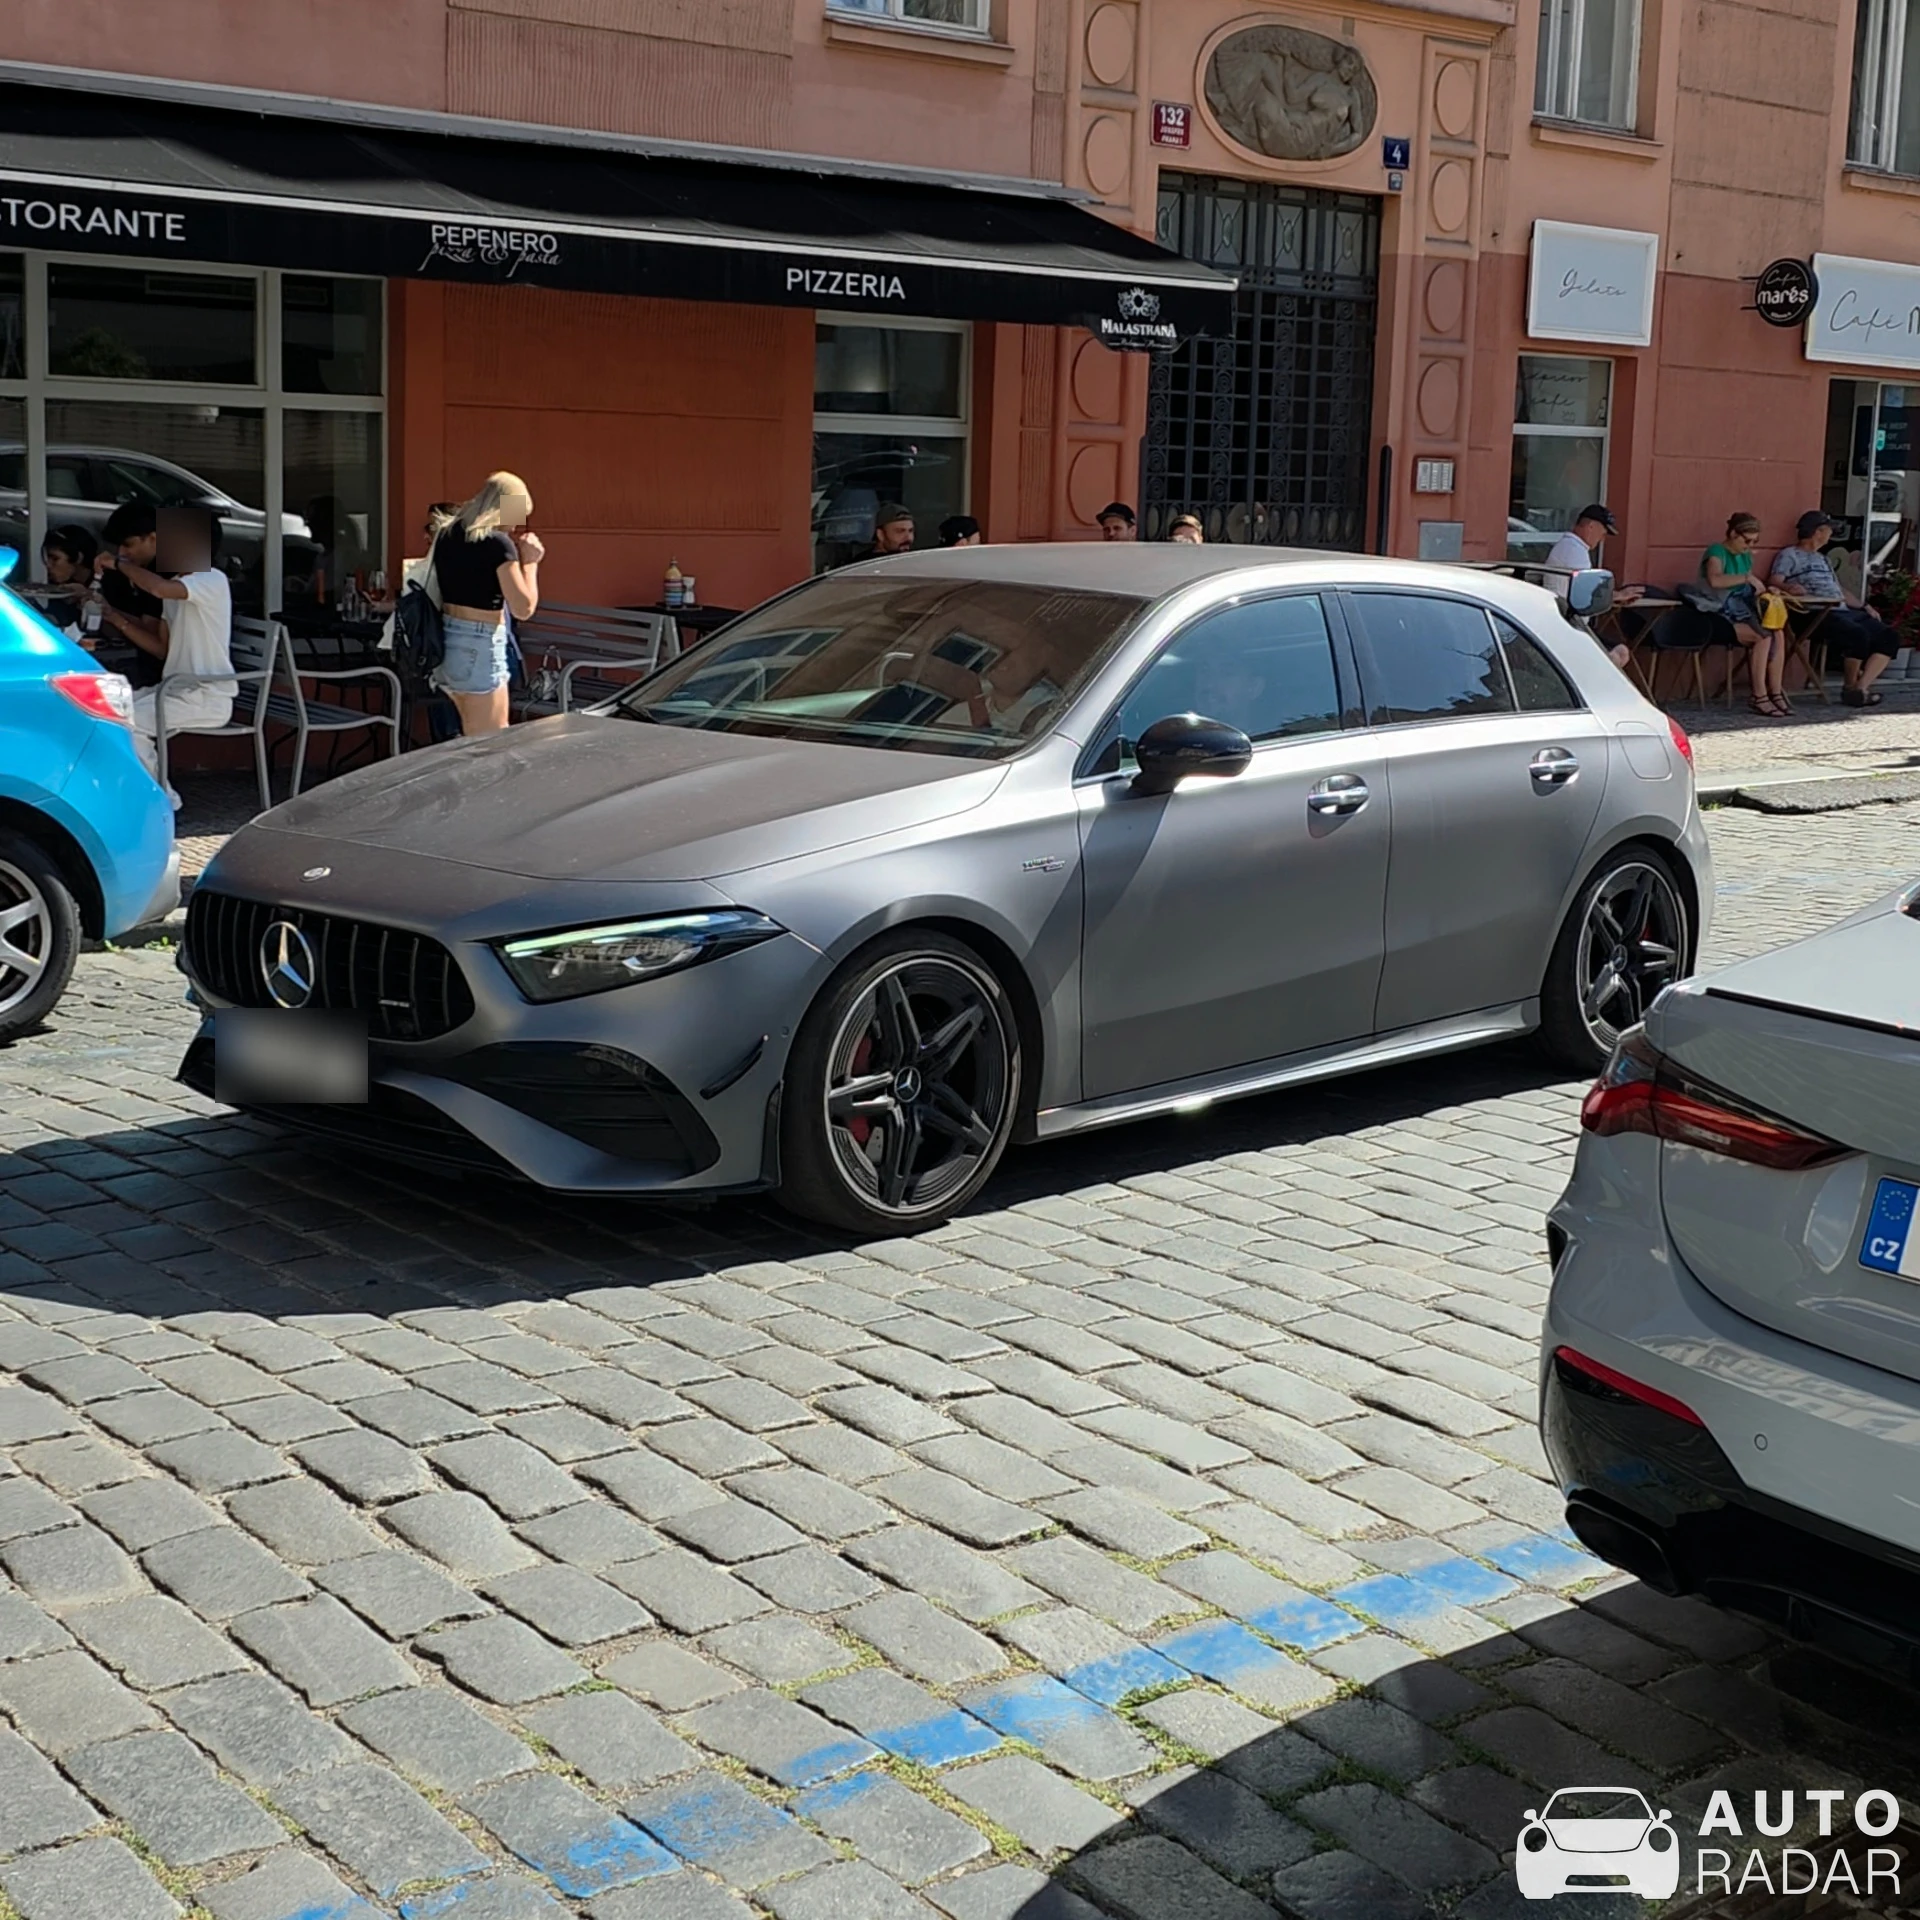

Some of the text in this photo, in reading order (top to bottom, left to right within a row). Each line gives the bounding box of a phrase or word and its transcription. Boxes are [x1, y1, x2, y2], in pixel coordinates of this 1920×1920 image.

[1160, 105, 1185, 126] 132
[1391, 144, 1402, 163] 4
[0, 198, 186, 241] TORANTE
[431, 224, 558, 254] PEPENERO
[505, 249, 563, 278] pasta
[786, 267, 906, 300] PIZZERIA
[1101, 318, 1178, 338] MALASTRANA
[1869, 1237, 1900, 1262] CZ
